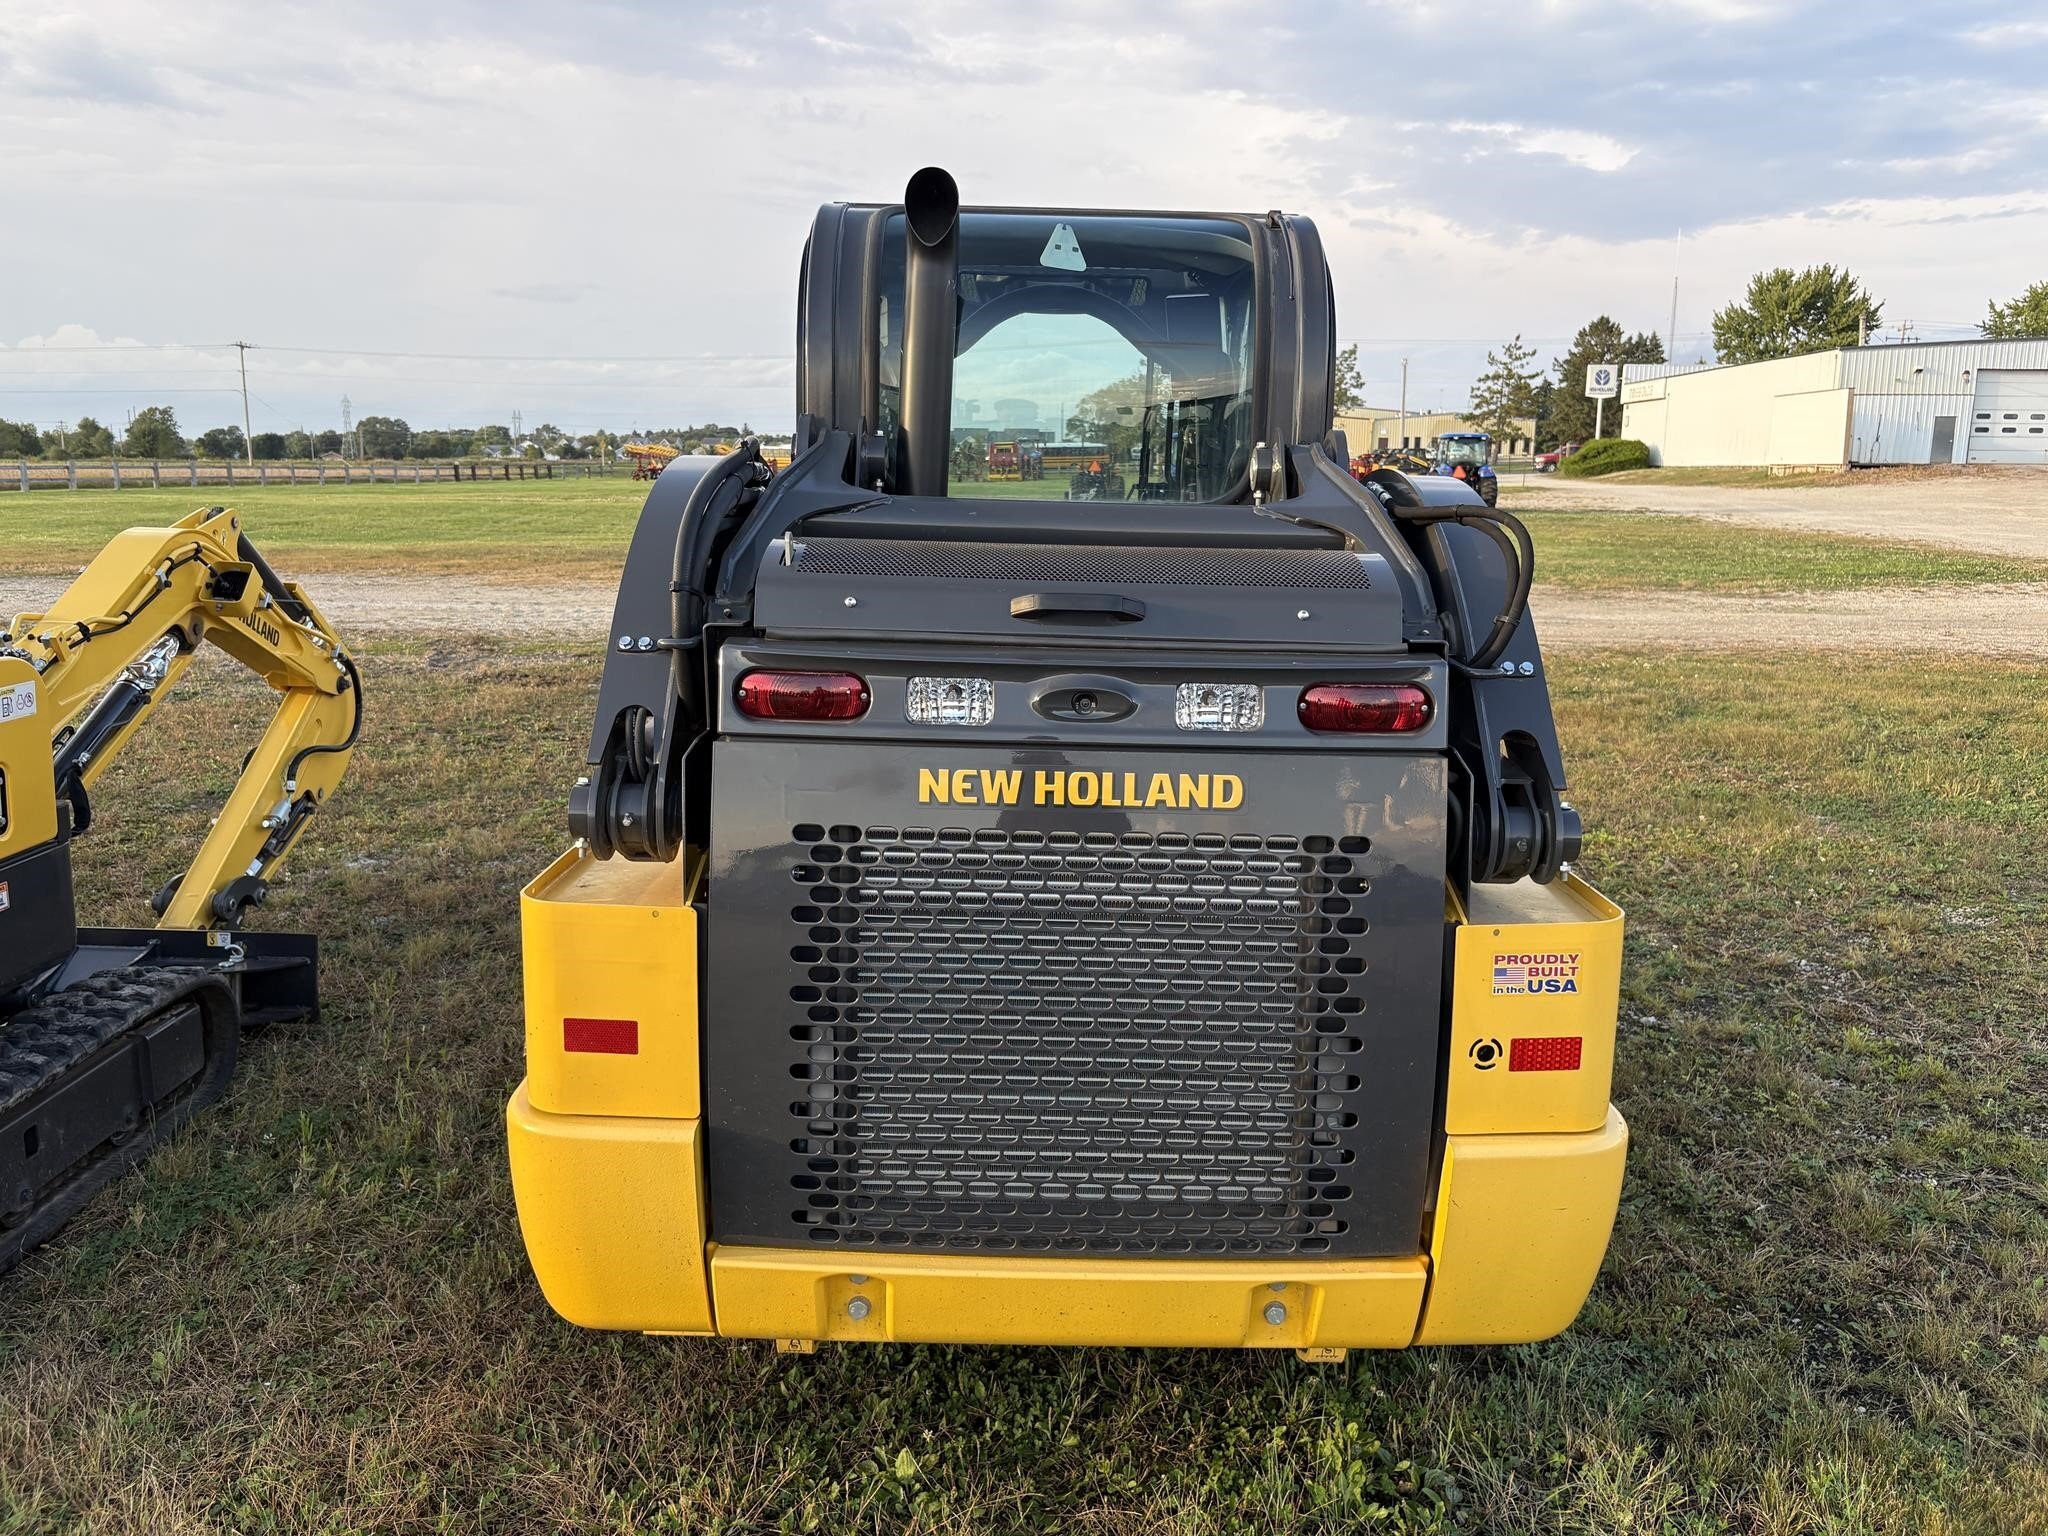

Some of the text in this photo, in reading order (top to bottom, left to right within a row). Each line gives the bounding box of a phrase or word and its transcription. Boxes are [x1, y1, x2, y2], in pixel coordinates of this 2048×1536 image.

[918, 768, 1244, 809] NEW HOLLAND
[1494, 954, 1579, 965] PROUDLY
[1528, 966, 1579, 977] BUILT
[1493, 979, 1578, 994] in the USA
